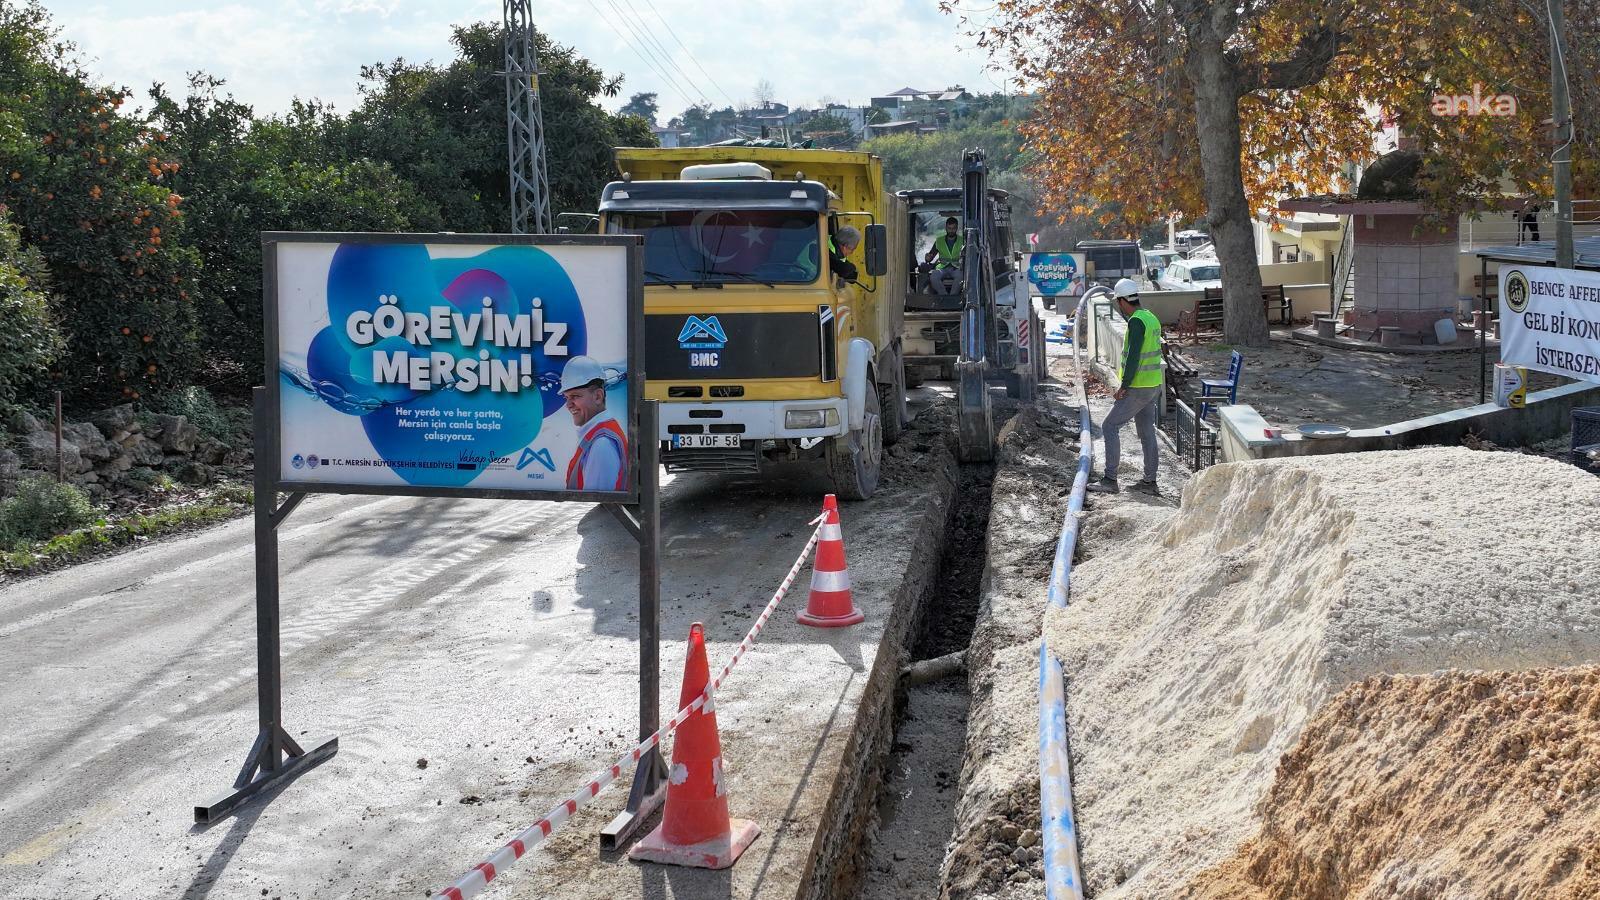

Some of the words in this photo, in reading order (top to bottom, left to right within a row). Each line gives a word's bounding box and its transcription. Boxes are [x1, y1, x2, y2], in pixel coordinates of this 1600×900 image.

[1033, 262, 1074, 273] GÖREVİMİZ
[1038, 271, 1068, 280] MERSİN!
[1531, 281, 1565, 298] BENCE
[346, 294, 568, 356] GÖREVİMİZ
[1523, 312, 1548, 332] GEL
[1551, 310, 1564, 334] Bİ
[1568, 317, 1600, 341] KON
[691, 353, 718, 367] BMC
[373, 349, 532, 393] MERSİN!
[395, 407, 412, 416] Her
[414, 408, 441, 419] yerde
[456, 408, 471, 417] her
[474, 410, 504, 420] şartta,
[398, 419, 429, 428] Mersin
[431, 420, 446, 430] için
[449, 420, 474, 429] canla
[476, 421, 501, 431] başla
[424, 431, 475, 442] çalışıyoruz.
[680, 436, 693, 446] 33
[699, 436, 718, 446] VDF
[725, 436, 738, 446] 58
[345, 458, 371, 467] MERSİN
[418, 460, 455, 469] BELEDİYESİ
